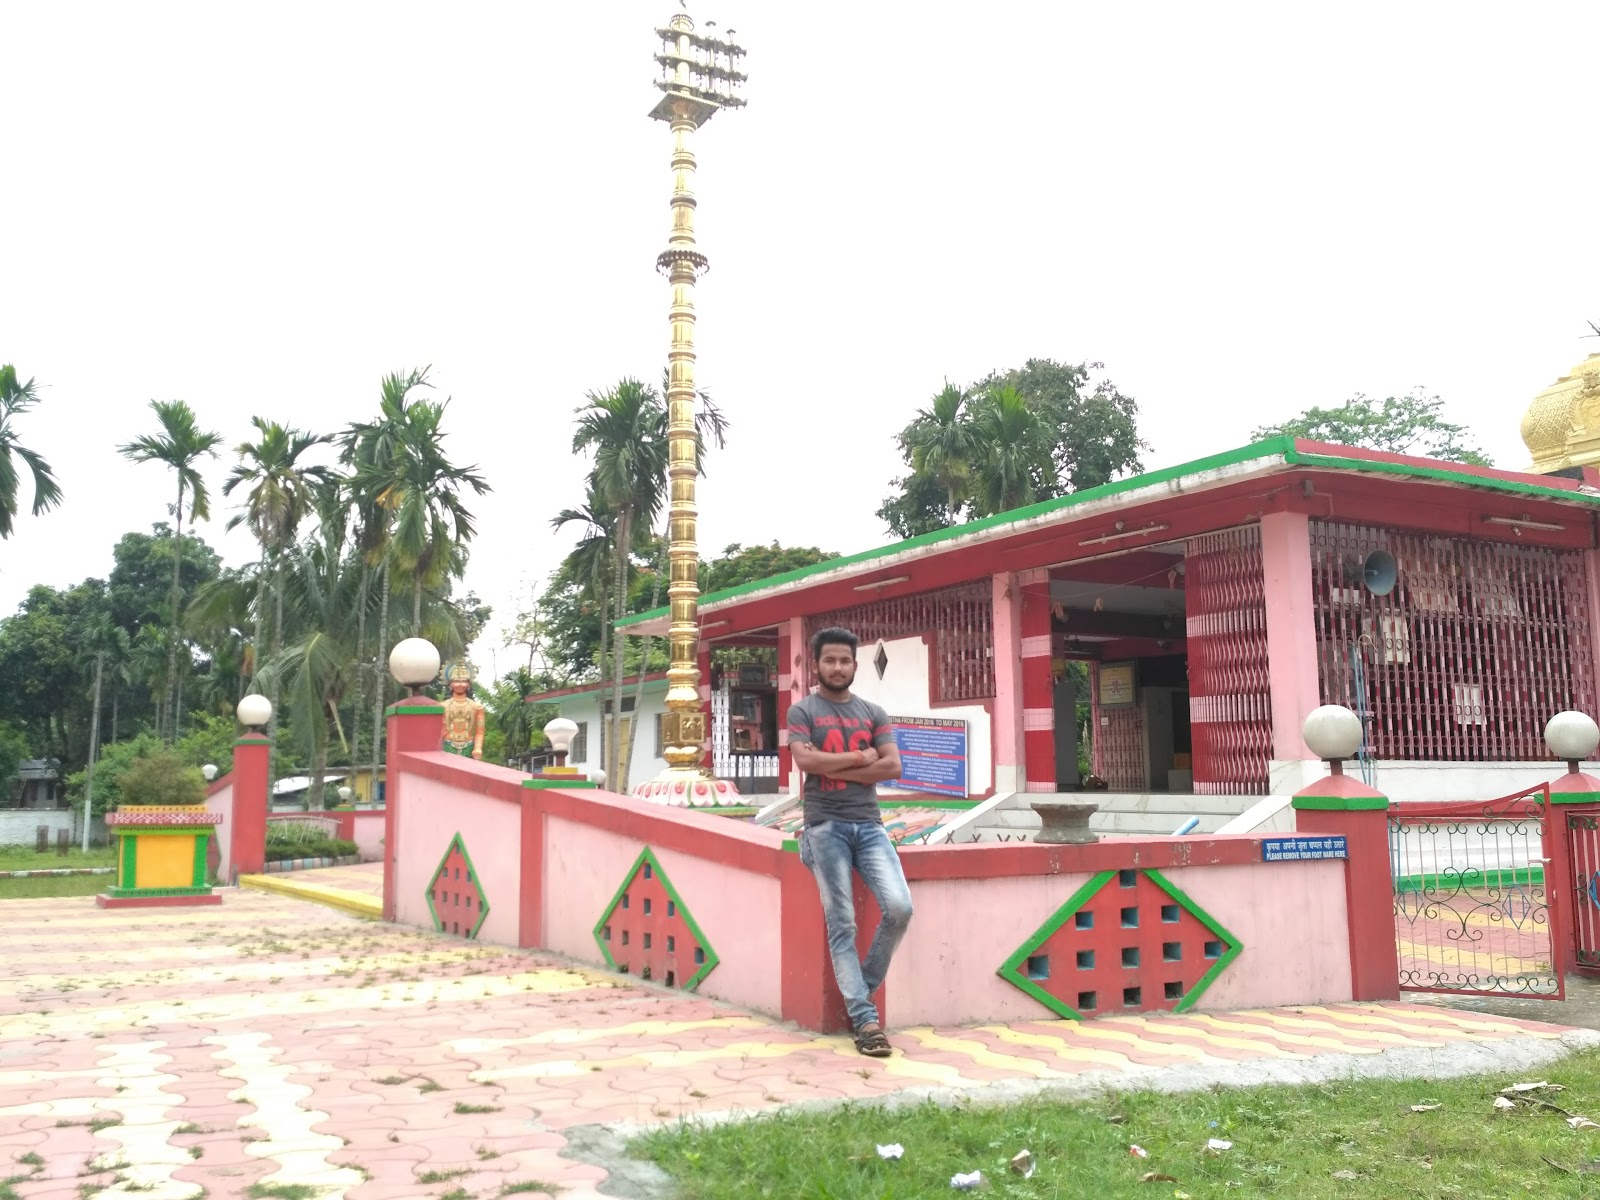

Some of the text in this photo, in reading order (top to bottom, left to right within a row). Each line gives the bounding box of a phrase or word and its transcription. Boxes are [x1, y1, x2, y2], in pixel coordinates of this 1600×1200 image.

[901, 717, 914, 725] FROM
[1267, 852, 1282, 860] PLEASE
[1282, 852, 1300, 860] REMOVE
[1300, 851, 1311, 859] YOUR
[1311, 851, 1322, 859] FOOT
[1334, 850, 1346, 858] HERE
